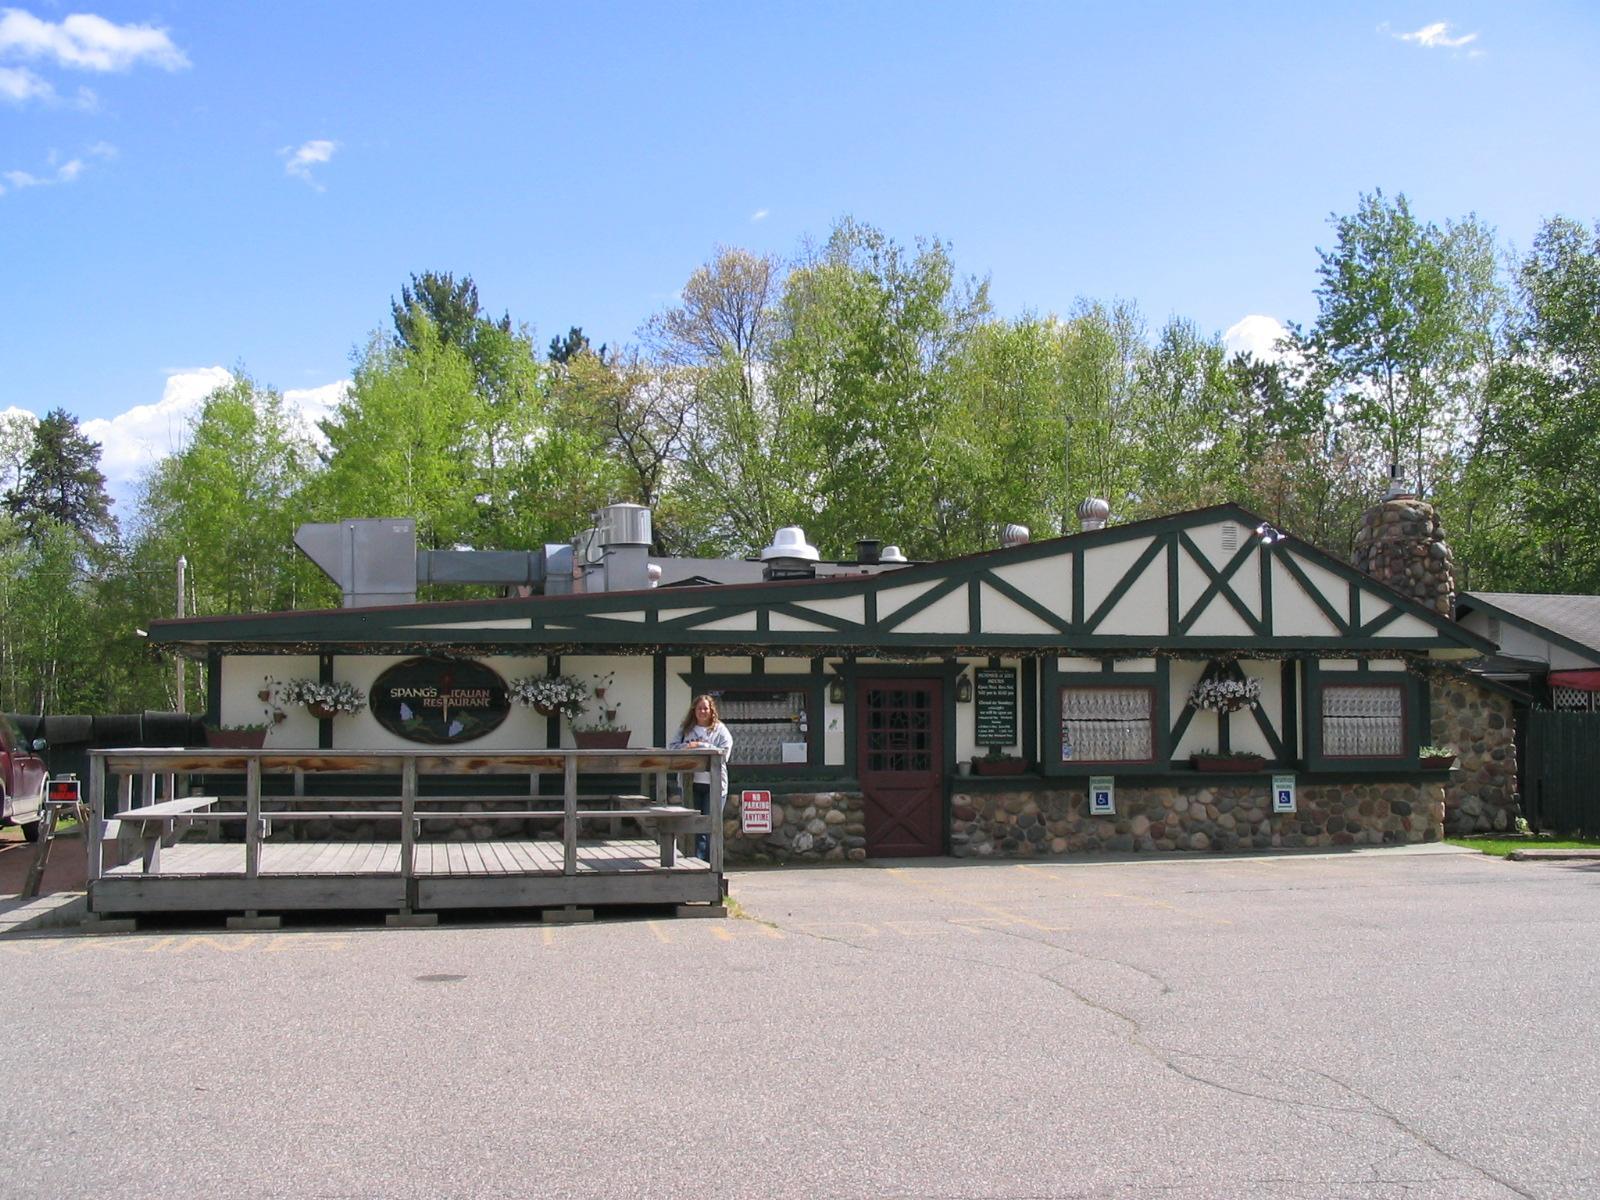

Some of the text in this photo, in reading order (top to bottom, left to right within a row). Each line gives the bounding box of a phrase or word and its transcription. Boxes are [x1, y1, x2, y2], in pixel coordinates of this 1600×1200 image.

[390, 687, 490, 698] SPANG'S ITALIAN
[423, 697, 490, 707] RESTAURANT
[752, 793, 761, 801] NO
[744, 801, 769, 809] PARKING
